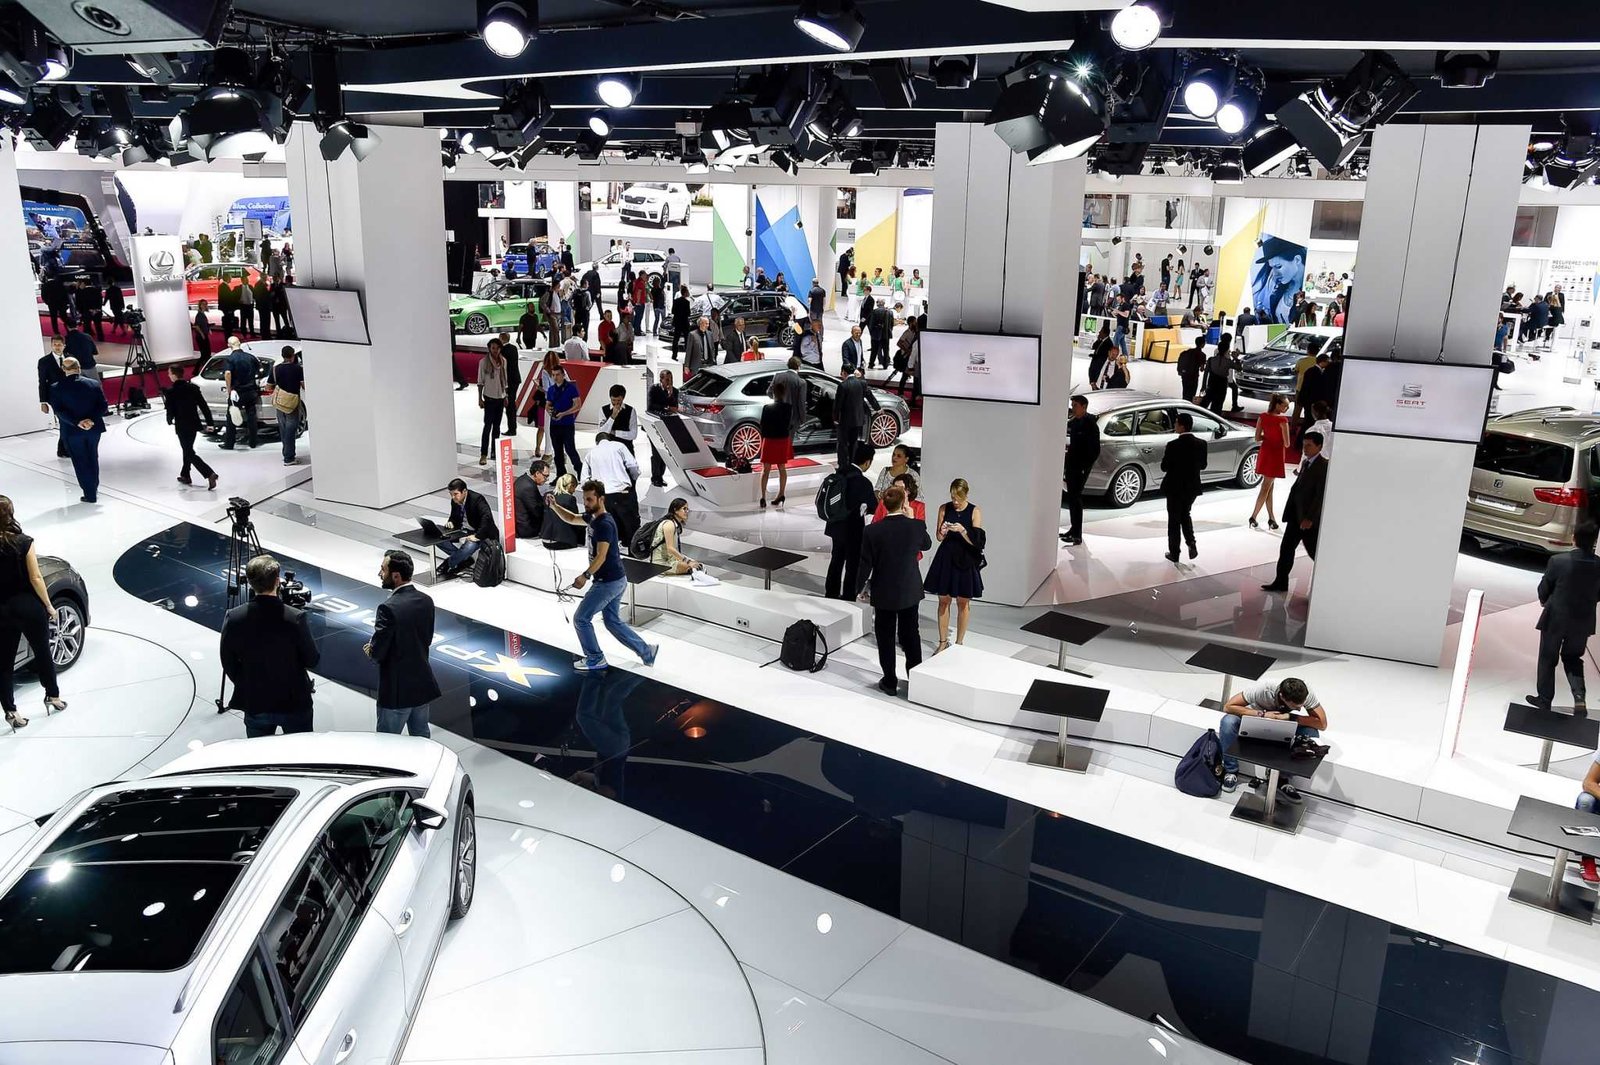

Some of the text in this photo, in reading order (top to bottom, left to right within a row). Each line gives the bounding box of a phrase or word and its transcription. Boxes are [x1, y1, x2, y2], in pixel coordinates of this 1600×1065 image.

[142, 275, 185, 283] LEXUS
[503, 465, 511, 498] Working
[504, 499, 512, 520] Press
